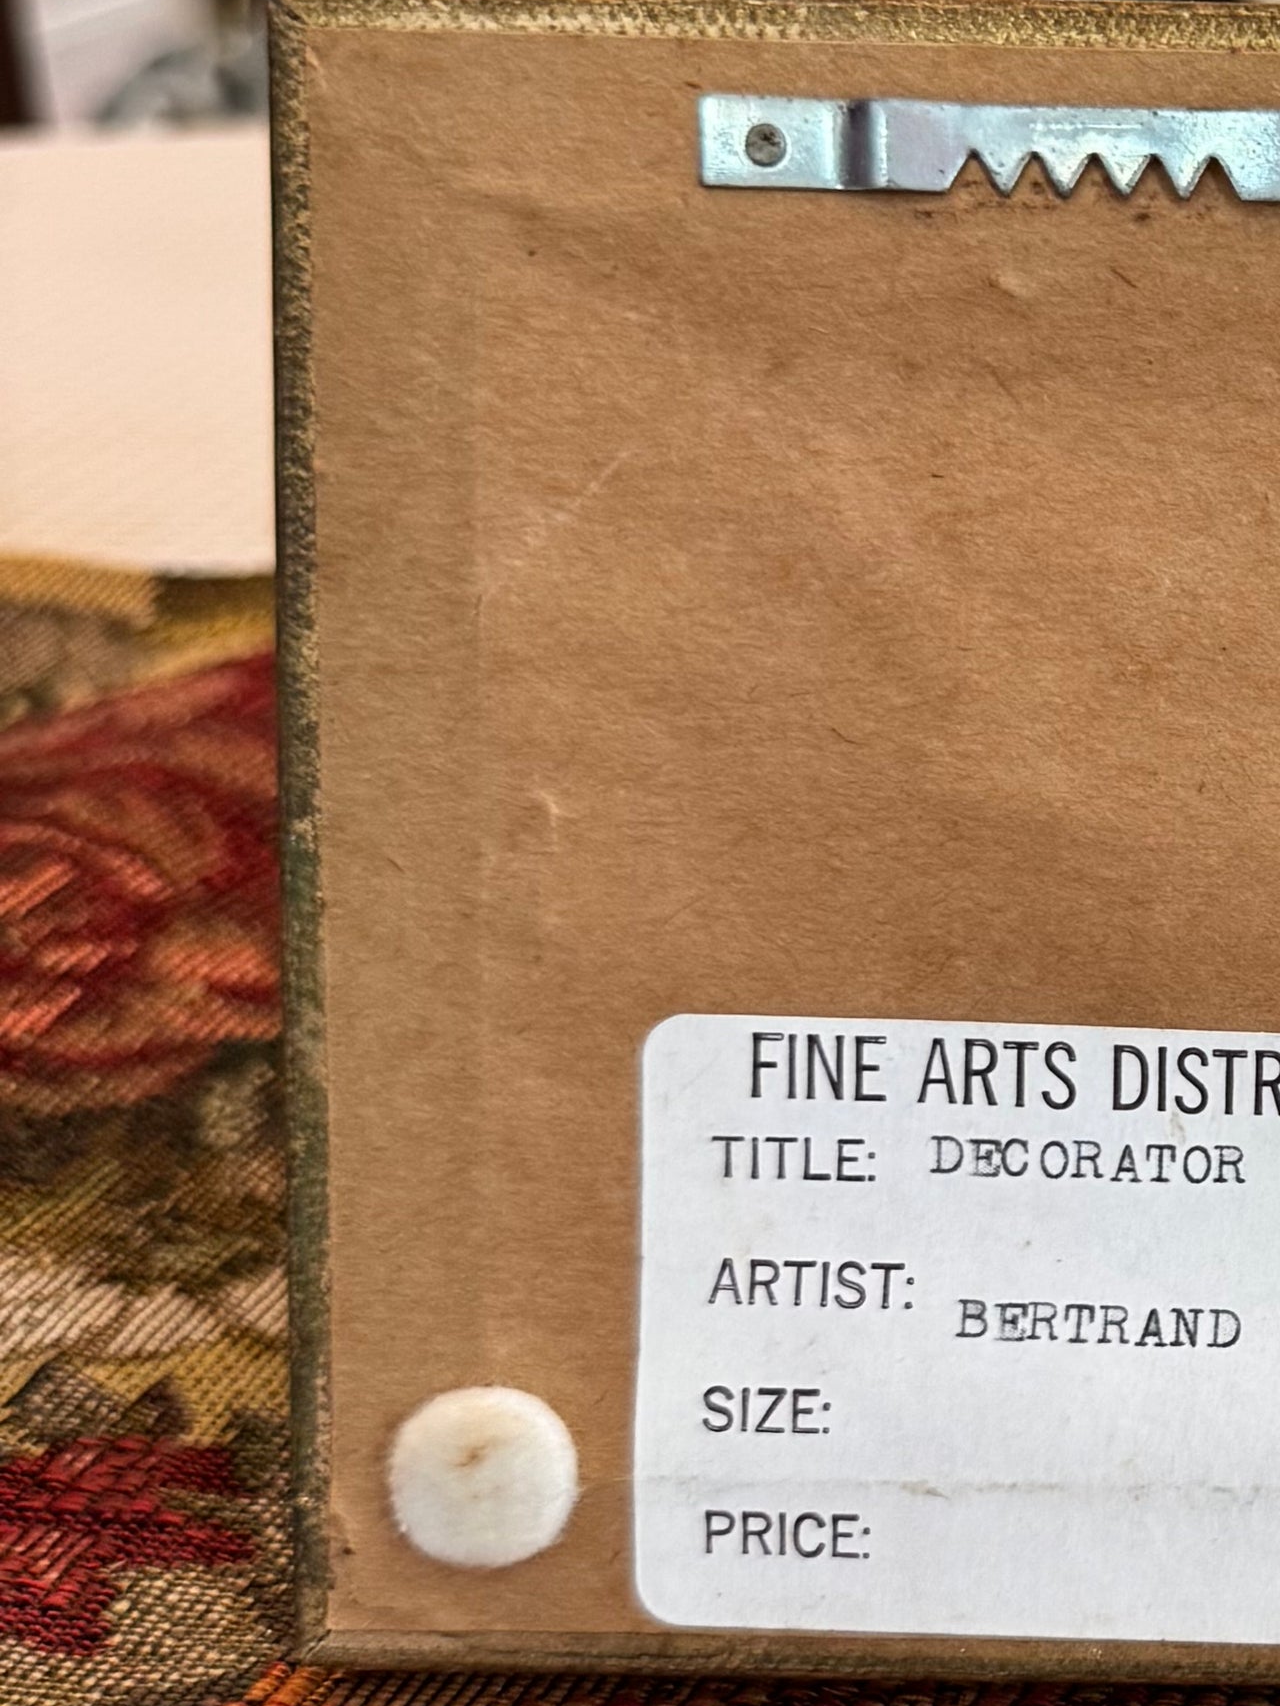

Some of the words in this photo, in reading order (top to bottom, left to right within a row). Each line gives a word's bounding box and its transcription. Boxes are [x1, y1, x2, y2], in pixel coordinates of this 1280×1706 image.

[750, 1033, 887, 1102] FINE
[917, 1039, 1076, 1110] ARTS
[711, 1136, 876, 1182] TITLE:
[930, 1136, 1246, 1184] DECORATOR
[708, 1258, 914, 1309] ARTIST:
[955, 1299, 1241, 1348] BERTRAND
[702, 1386, 831, 1434] SIZE:
[704, 1510, 870, 1559] PRICE:
